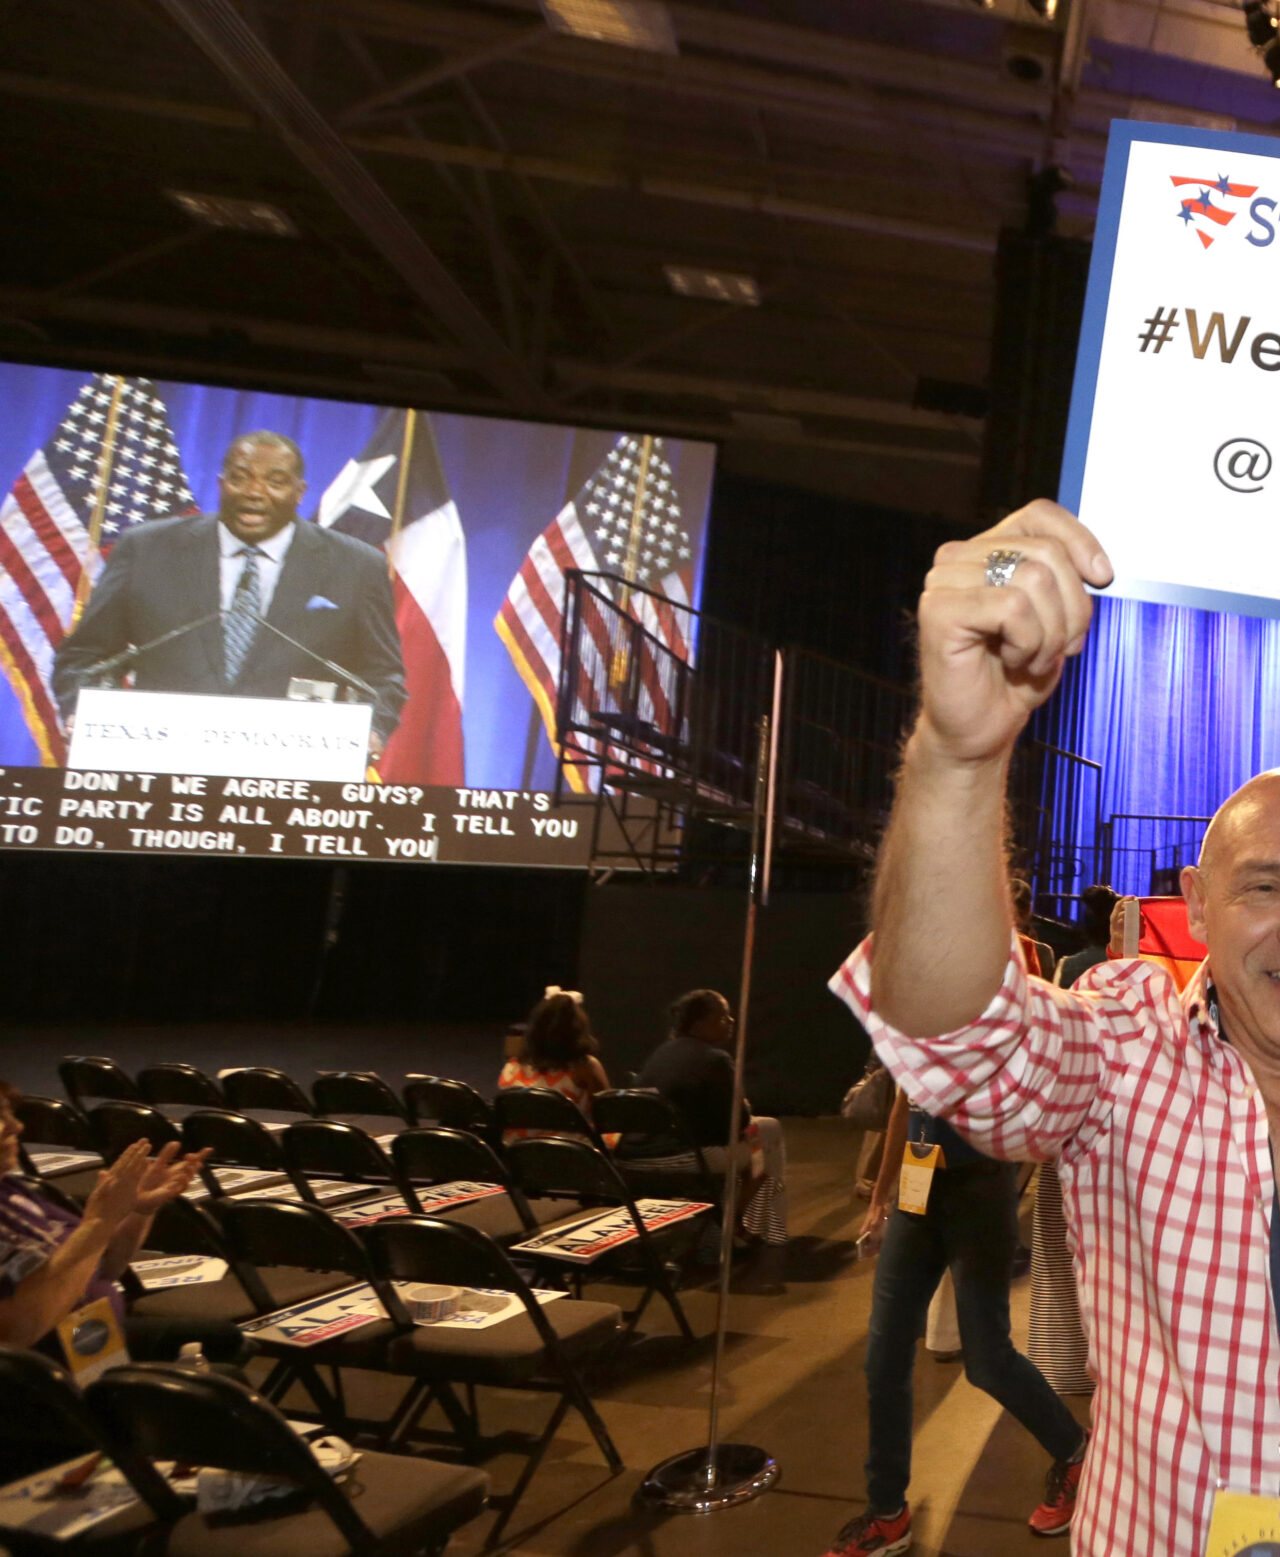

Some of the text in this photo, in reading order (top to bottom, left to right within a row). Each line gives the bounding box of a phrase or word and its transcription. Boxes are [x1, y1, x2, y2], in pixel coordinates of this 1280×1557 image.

[64, 771, 550, 811] DON'T WE AGREE, GUYS? THAT'S
[0, 796, 578, 838] IC PARTY IS ALL ABOUT. I TELL YOU
[1, 824, 433, 858] TO DO, THOUGH, I TELL YOU
